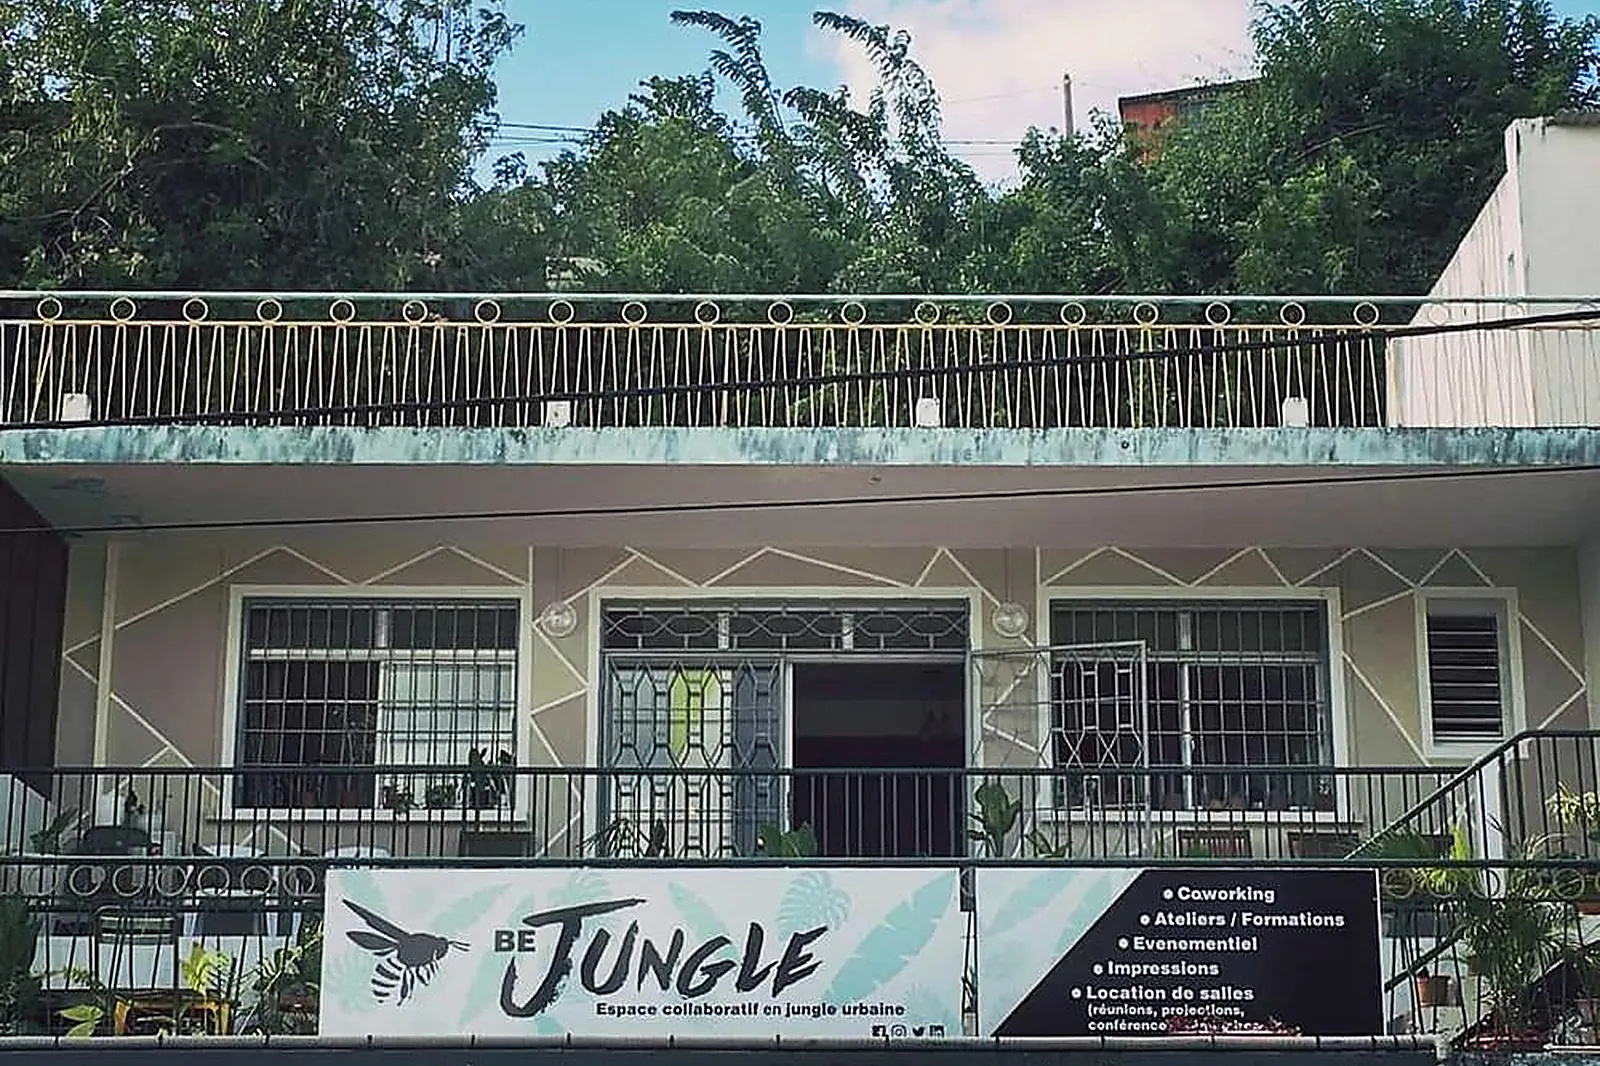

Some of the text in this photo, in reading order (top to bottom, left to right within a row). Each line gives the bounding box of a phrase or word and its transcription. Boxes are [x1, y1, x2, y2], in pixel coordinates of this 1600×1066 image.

[1177, 886, 1275, 903] Coworking
[1155, 912, 1345, 927] Ateliers / Formations
[494, 930, 535, 953] BE
[1133, 937, 1257, 951] Evenementiel
[1108, 961, 1219, 977] Impressions
[1086, 986, 1254, 1000] Location de salles
[596, 1002, 905, 1018] Espace collaboratif en jungle urbaine
[1088, 1004, 1244, 1017] (réunions, projections,
[1088, 1019, 1172, 1031] conférence
